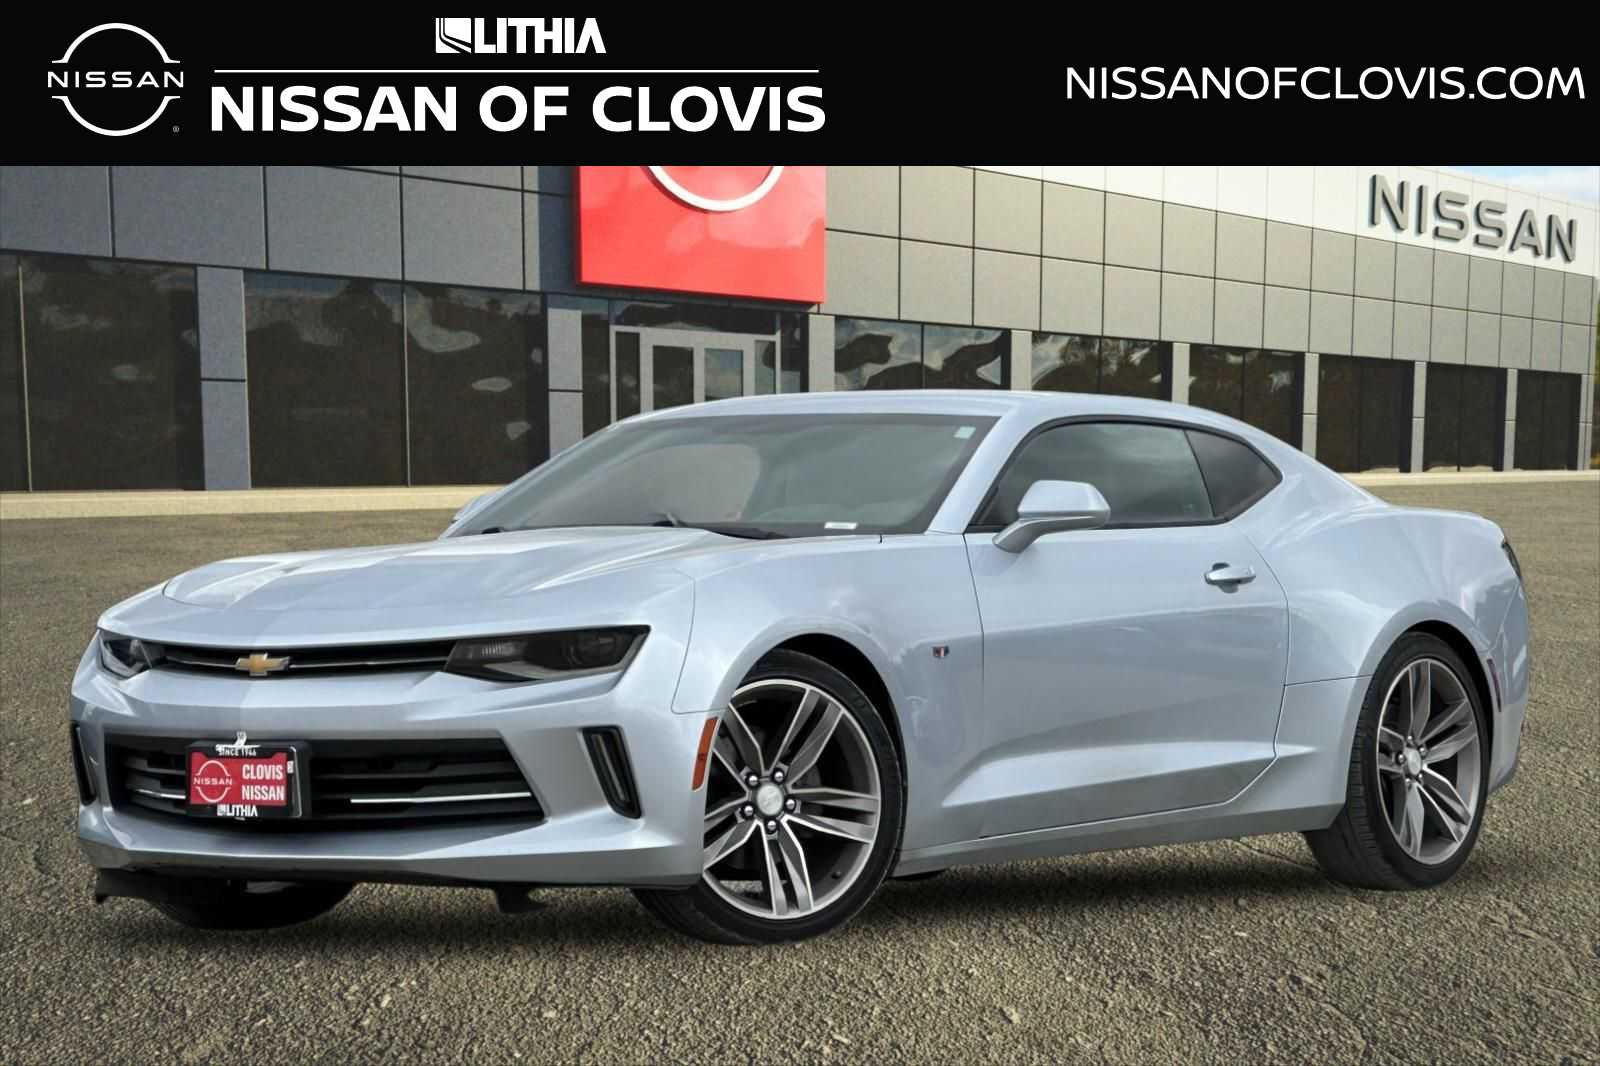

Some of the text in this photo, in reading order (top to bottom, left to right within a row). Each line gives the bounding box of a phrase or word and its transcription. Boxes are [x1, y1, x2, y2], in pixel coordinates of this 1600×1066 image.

[1369, 174, 1577, 262] NISSAN
[242, 764, 283, 780] CLOVIS
[193, 777, 232, 785] NISSAN
[241, 785, 285, 801] NISSAN
[226, 804, 258, 817] LITHIA
